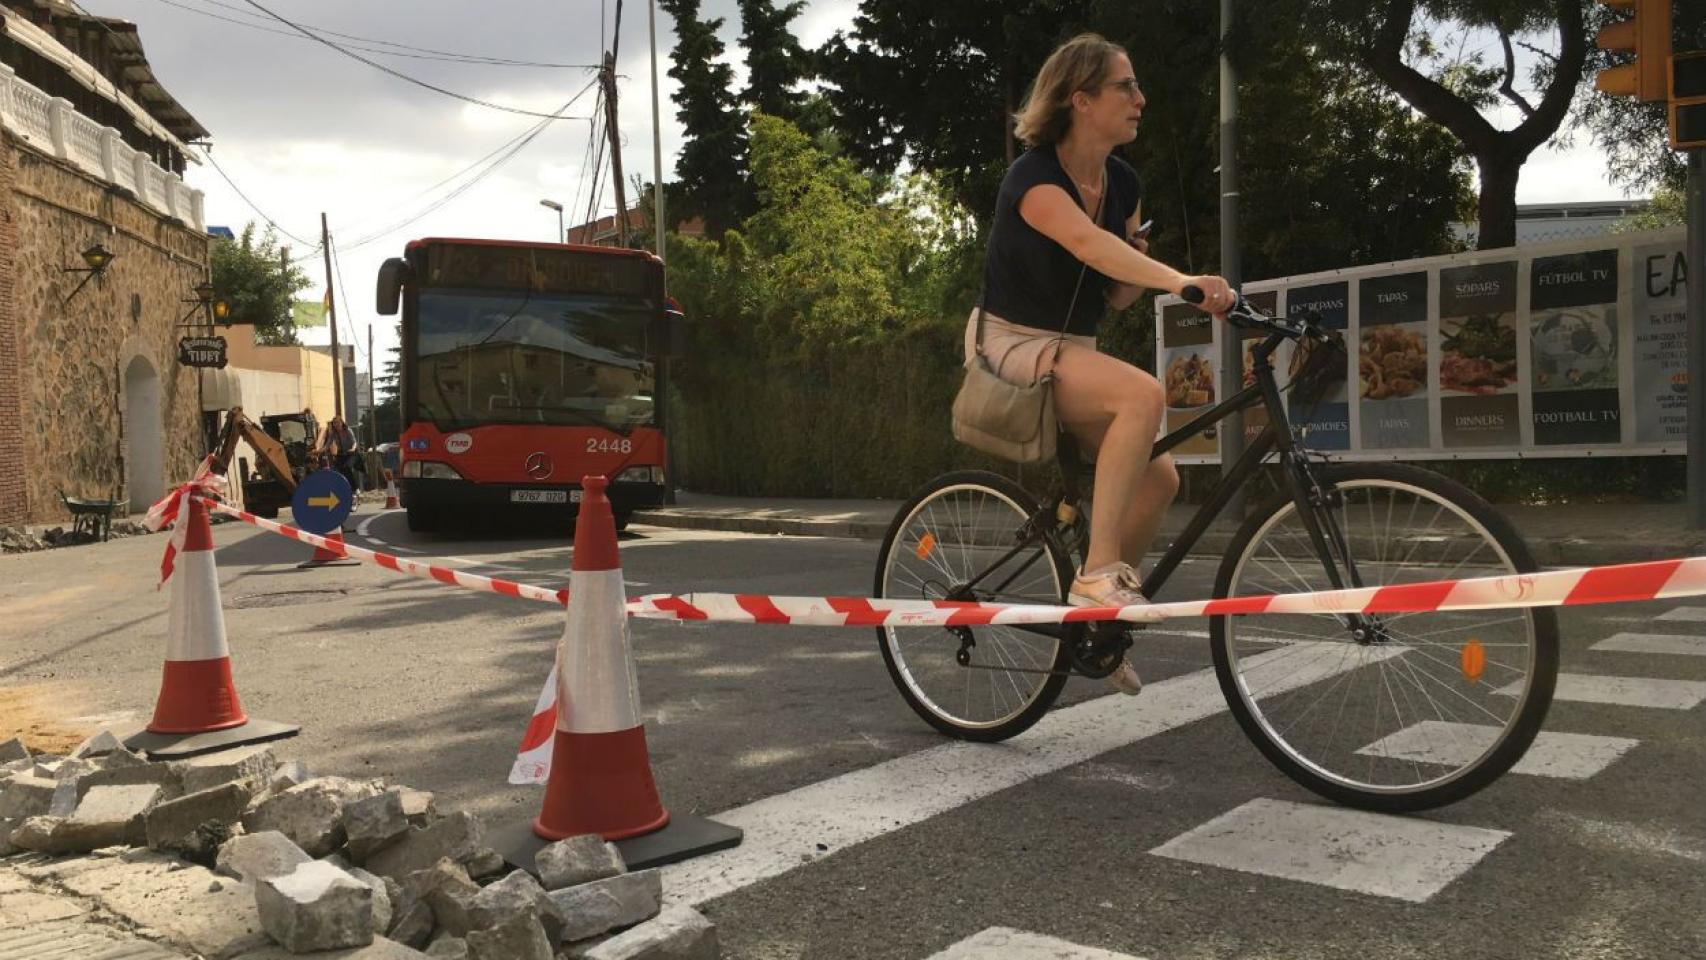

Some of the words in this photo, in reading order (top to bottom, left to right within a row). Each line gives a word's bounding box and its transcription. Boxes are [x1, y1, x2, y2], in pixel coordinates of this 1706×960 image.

[1593, 269, 1609, 281] TV
[1376, 291, 1409, 304] TAPAS
[1455, 414, 1504, 426] DINNERS
[1534, 411, 1597, 424] FOOTBALL
[1601, 409, 1619, 421] TV
[1289, 420, 1348, 433] SDWICHES
[586, 437, 632, 453] 2448
